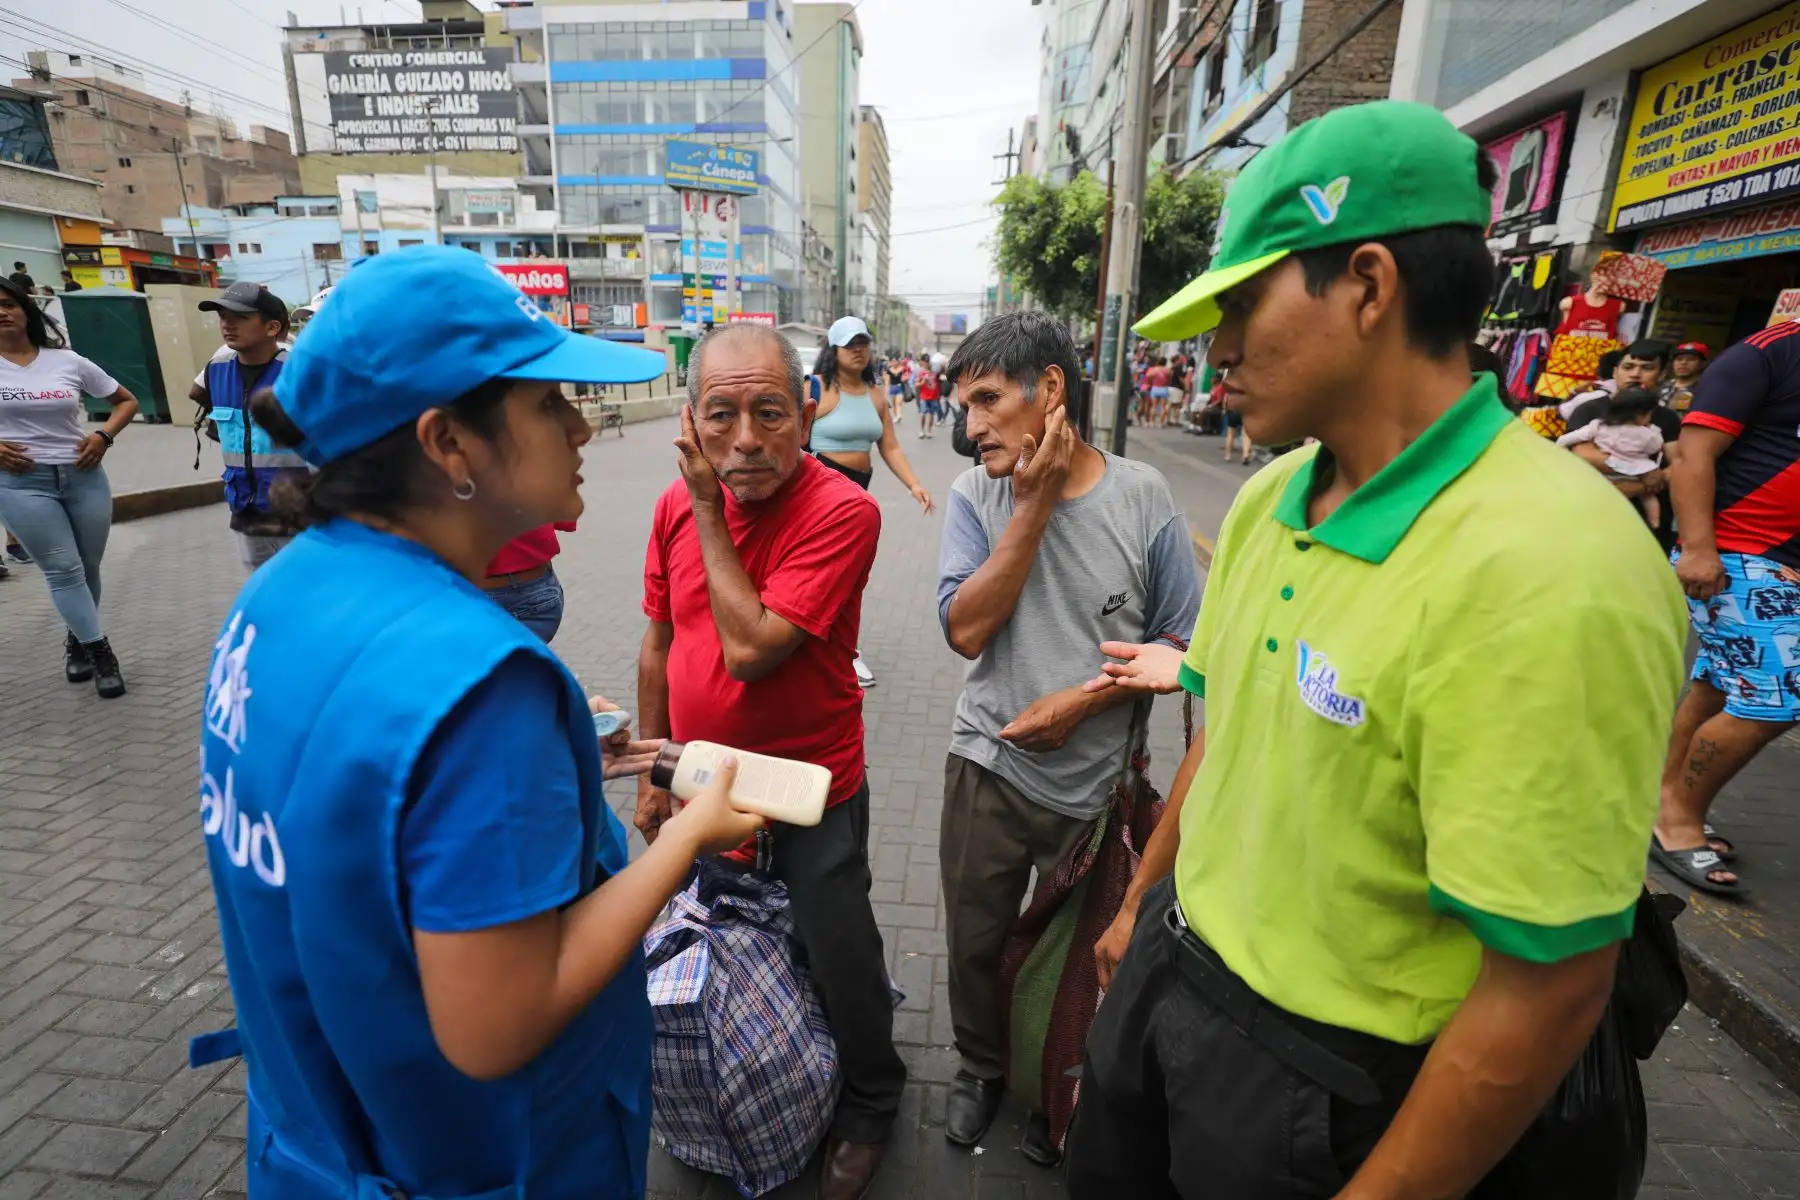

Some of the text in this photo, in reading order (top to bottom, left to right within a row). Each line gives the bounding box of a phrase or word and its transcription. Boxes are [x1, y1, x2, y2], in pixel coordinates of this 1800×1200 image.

[349, 51, 486, 67] CENTRO COMERCIAL
[328, 69, 512, 94] GALERÍA GUIZADO HNOS
[364, 96, 373, 116] E
[393, 119, 400, 133] A
[452, 117, 498, 133] COMPRAS
[1726, 117, 1785, 149] COLCHAS
[702, 162, 754, 182] Cánepa
[1668, 164, 1706, 188] VENTAS
[1717, 148, 1759, 174] MAYOR
[1763, 144, 1771, 162] Y
[1743, 172, 1772, 197] TDA
[0, 390, 72, 400] EXTILANDIA
[1108, 592, 1127, 606] NIKE
